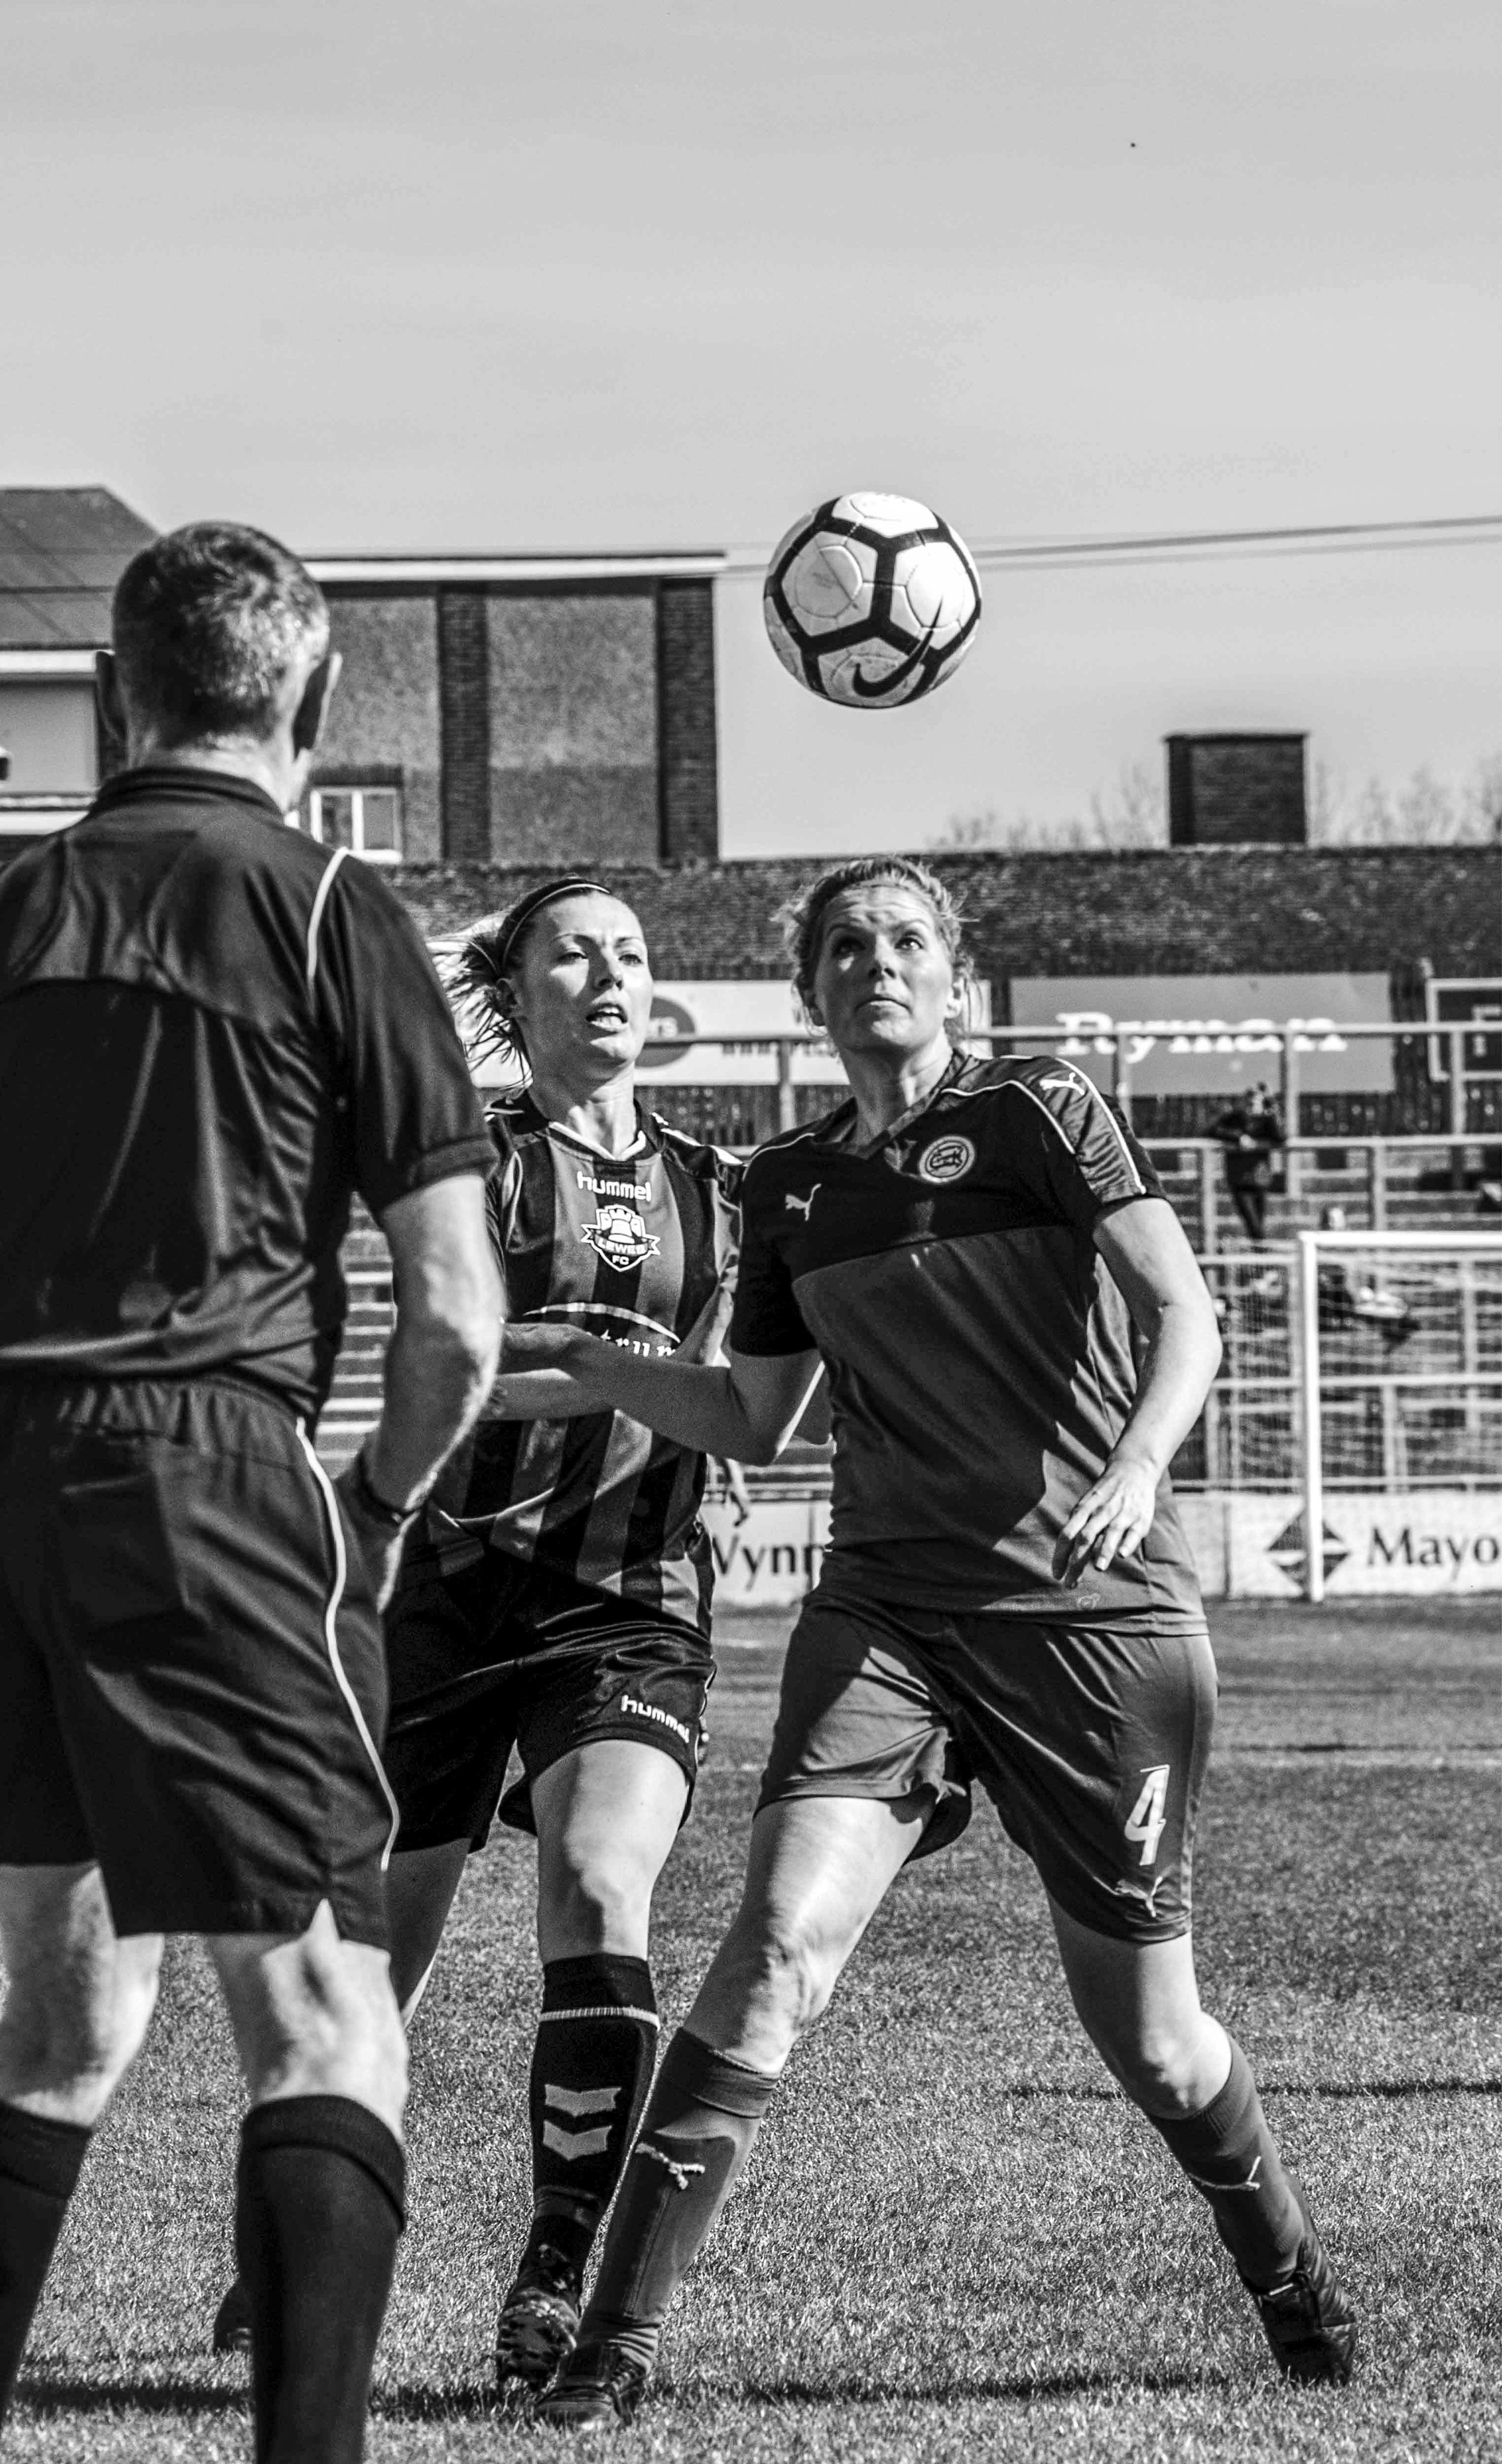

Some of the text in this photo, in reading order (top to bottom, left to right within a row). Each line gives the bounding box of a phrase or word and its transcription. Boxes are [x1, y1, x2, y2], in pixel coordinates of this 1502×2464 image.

[1056, 1012, 1348, 1063] Ryman
[577, 1171, 652, 1201] hummel
[612, 1254, 630, 1265] FC
[1368, 1526, 1500, 1582] Mayo
[621, 1695, 690, 1743] hummel
[1124, 1764, 1170, 1866] 4
